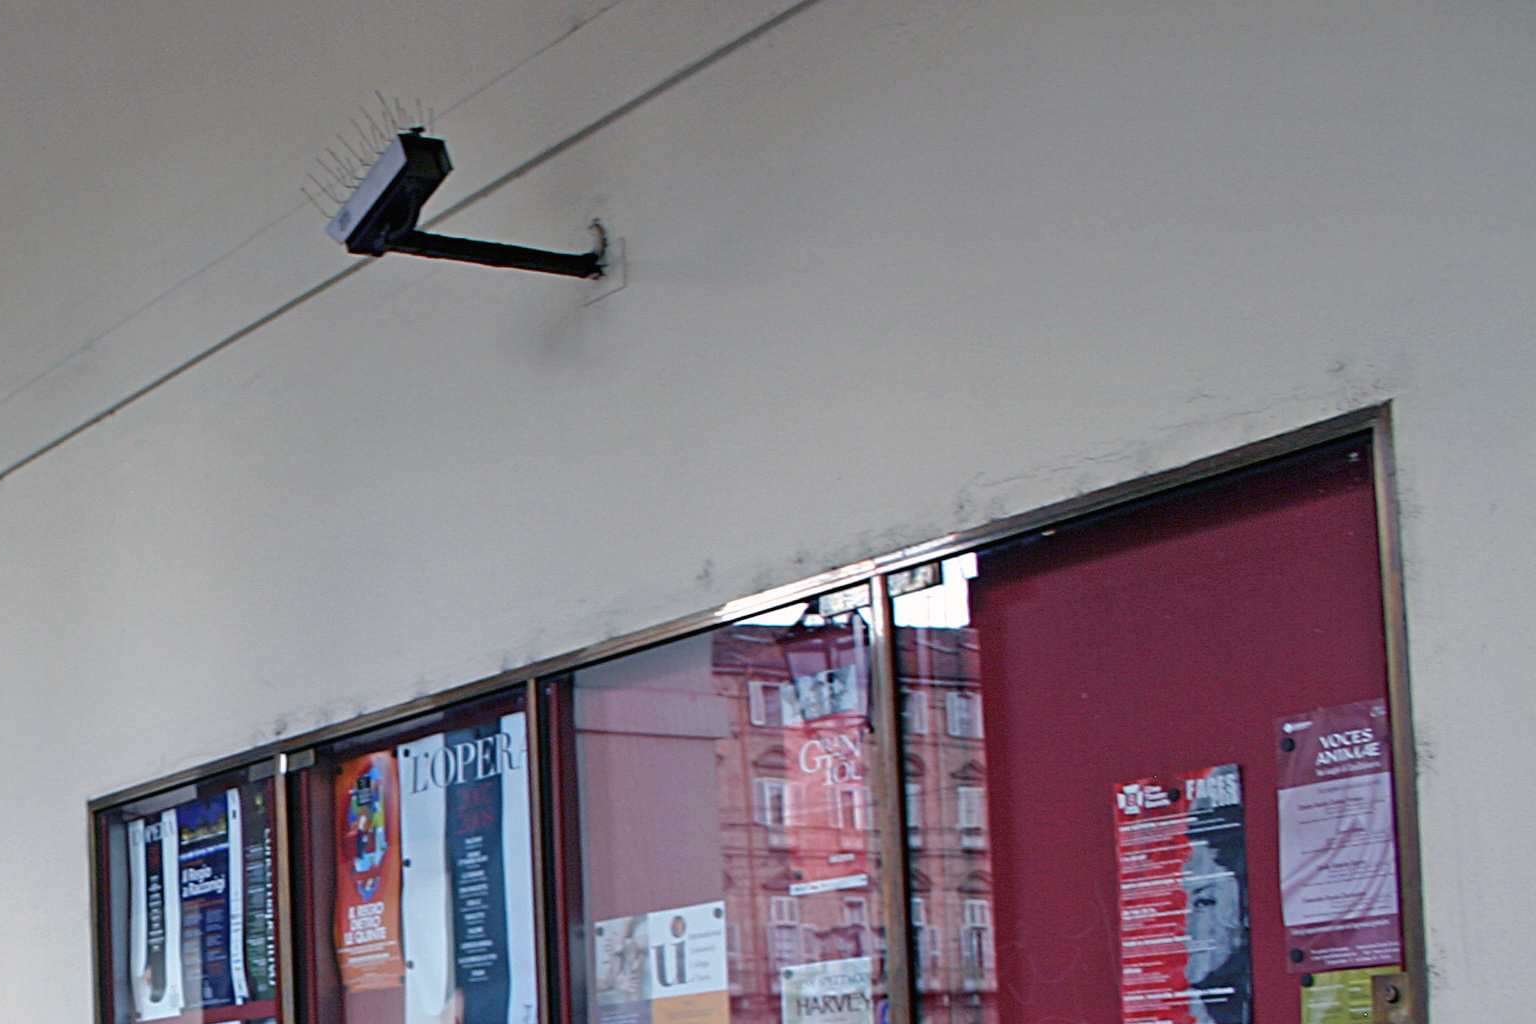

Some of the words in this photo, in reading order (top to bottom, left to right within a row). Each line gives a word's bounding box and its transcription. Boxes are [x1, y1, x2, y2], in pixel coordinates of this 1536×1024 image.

[1319, 727, 1374, 749] VOCES
[410, 732, 527, 794] L'OPER
[796, 992, 871, 1017] HARVEY
